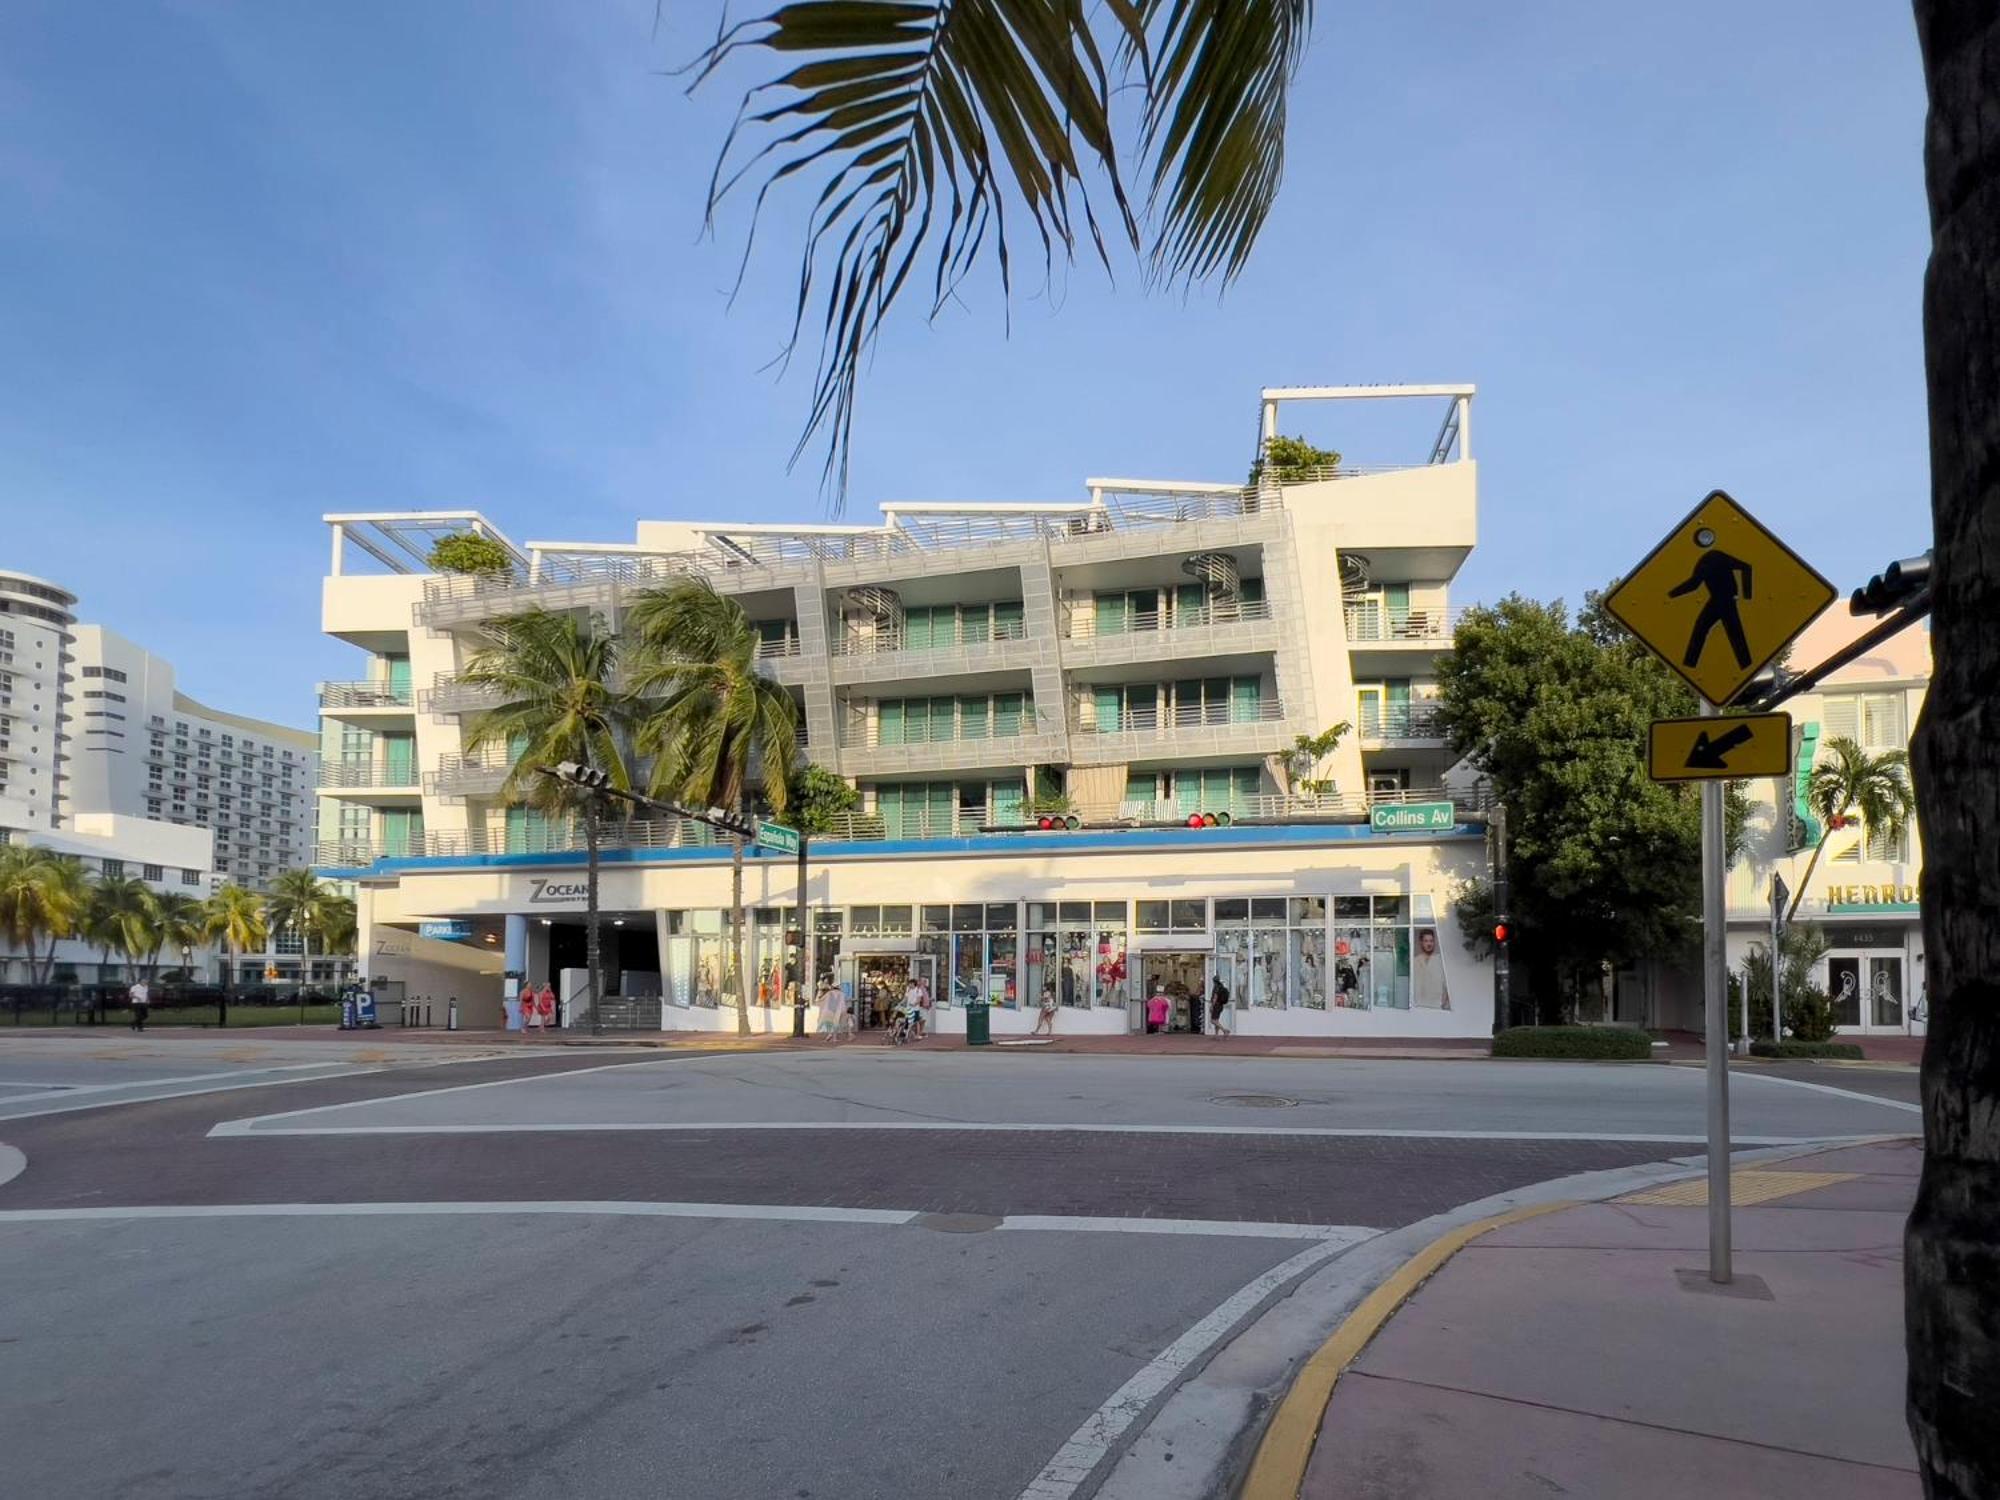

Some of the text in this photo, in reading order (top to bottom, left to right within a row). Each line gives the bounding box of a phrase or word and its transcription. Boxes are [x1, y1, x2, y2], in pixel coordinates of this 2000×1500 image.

[1375, 808, 1449, 826] Collins Av
[1827, 885, 1920, 904] HENRO
[356, 993, 372, 1015] P
